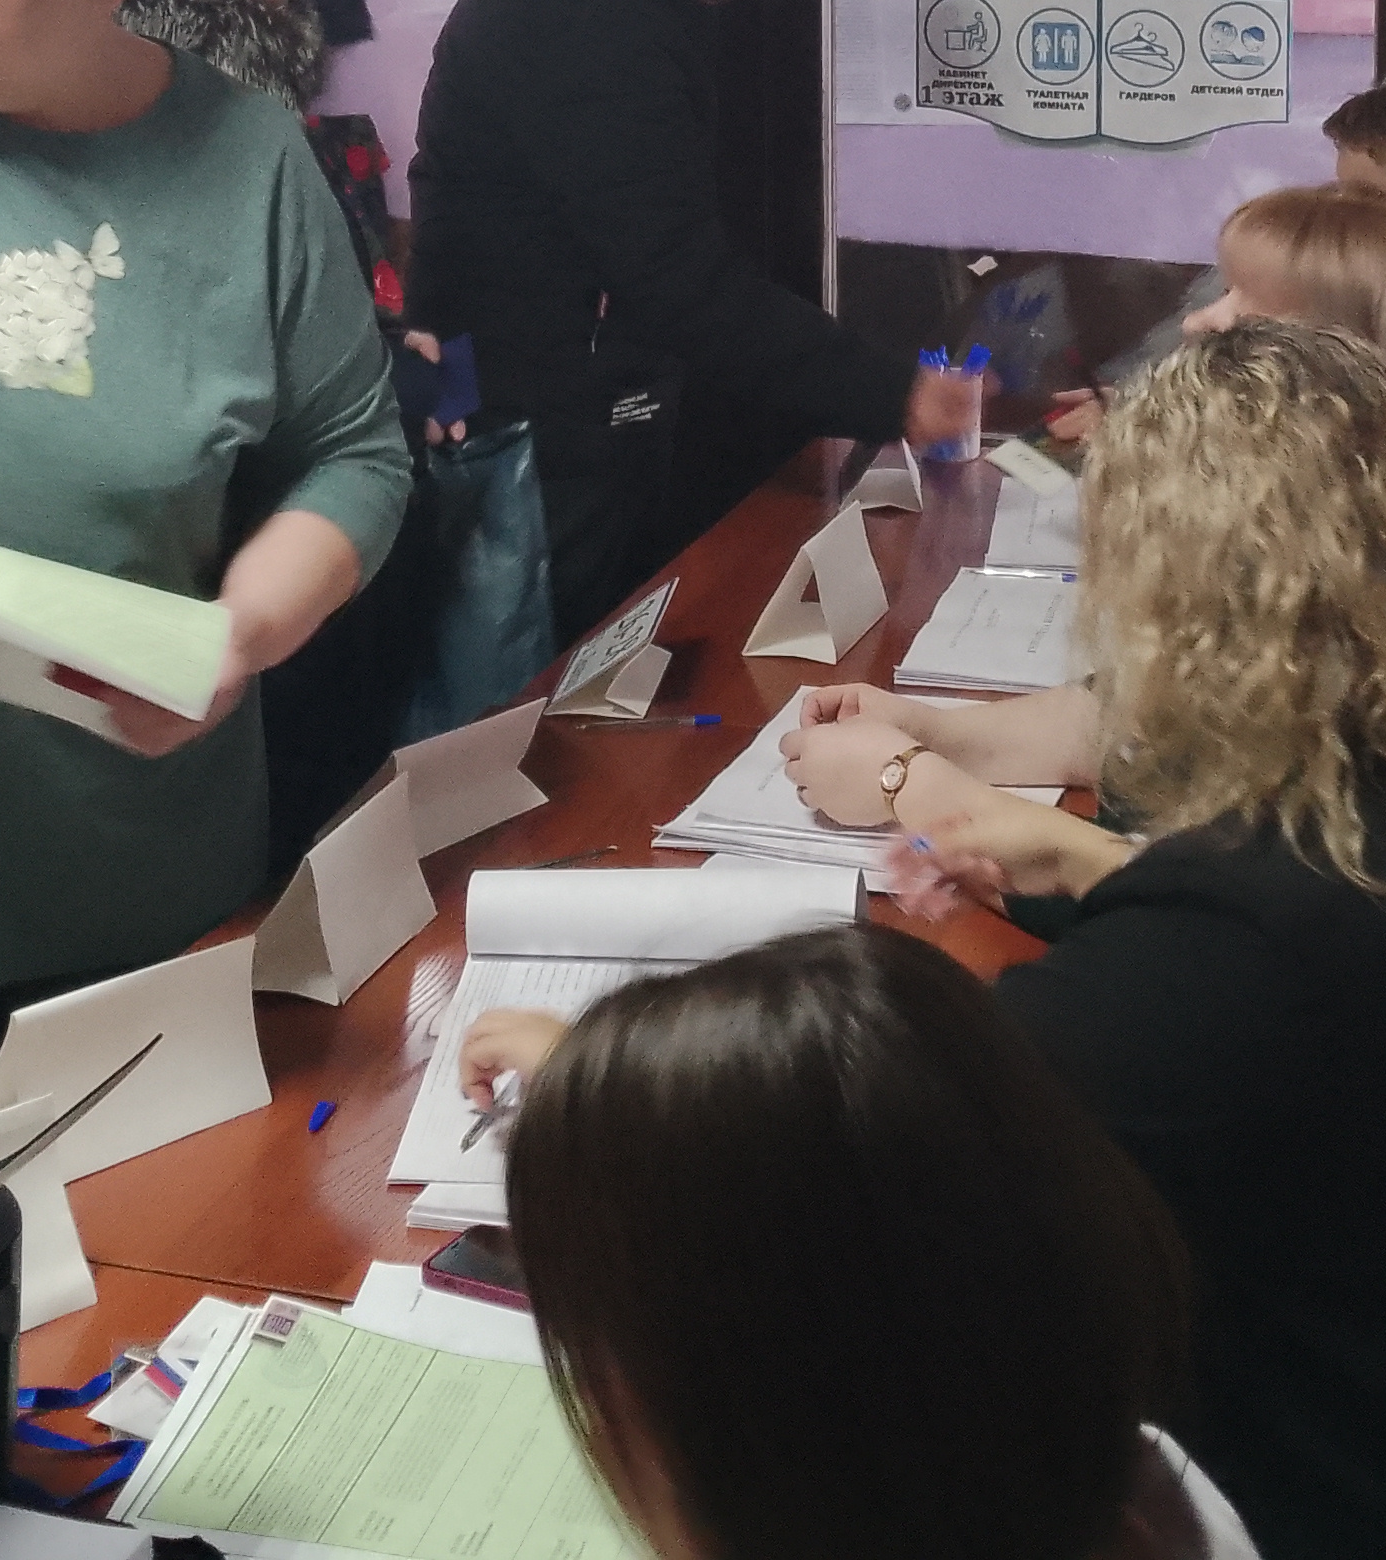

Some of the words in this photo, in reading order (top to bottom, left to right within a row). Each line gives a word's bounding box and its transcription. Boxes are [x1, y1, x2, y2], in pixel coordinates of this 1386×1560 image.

[938, 69, 988, 79] КАБИНЕТ
[931, 80, 995, 91] ДИРЕКТОРА
[1190, 84, 1243, 96] ДЕТСКИЙ
[1246, 87, 1285, 97] ОТДЕЛ
[921, 85, 934, 105] 1
[942, 91, 1004, 107] этаж
[1026, 90, 1090, 100] ТУАЛЕТНАЯ
[1032, 101, 1085, 111] КОМНАТА
